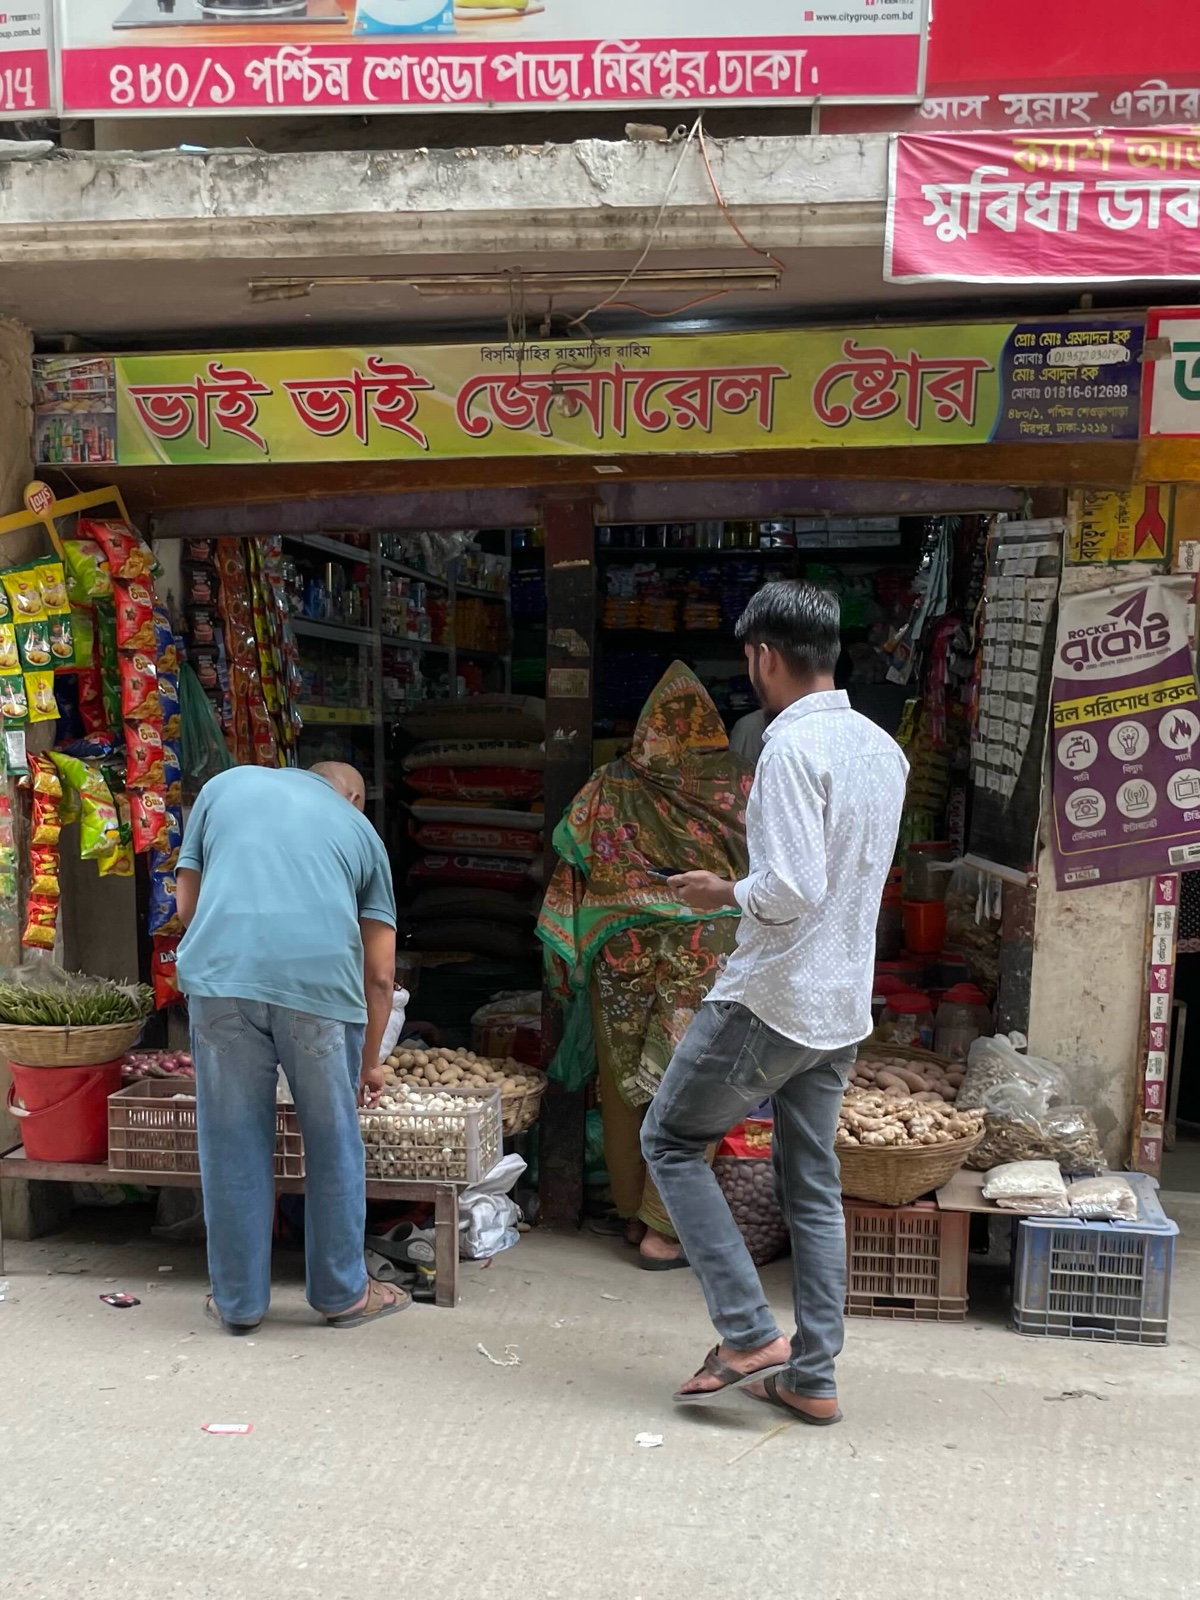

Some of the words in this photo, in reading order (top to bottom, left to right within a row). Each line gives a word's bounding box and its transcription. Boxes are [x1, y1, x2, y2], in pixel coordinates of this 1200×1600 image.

[816, 11, 913, 22] www.citygroup.com.bd
[245, 46, 352, 101] পশ্চিম
[998, 91, 1099, 126] সুন্নাহ
[1012, 137, 1115, 172] ক্যাশ
[921, 165, 1084, 242] সুবিধা
[617, 342, 652, 358] রাহিম
[126, 362, 273, 454] ভাই
[281, 355, 435, 451] ভাই
[455, 361, 791, 438] জেনারেল
[1044, 384, 1128, 399] 01816-612698
[1060, 612, 1171, 672] রকেট
[1068, 622, 1118, 640] ROCKET
[1084, 692, 1150, 718] পরিশোধ
